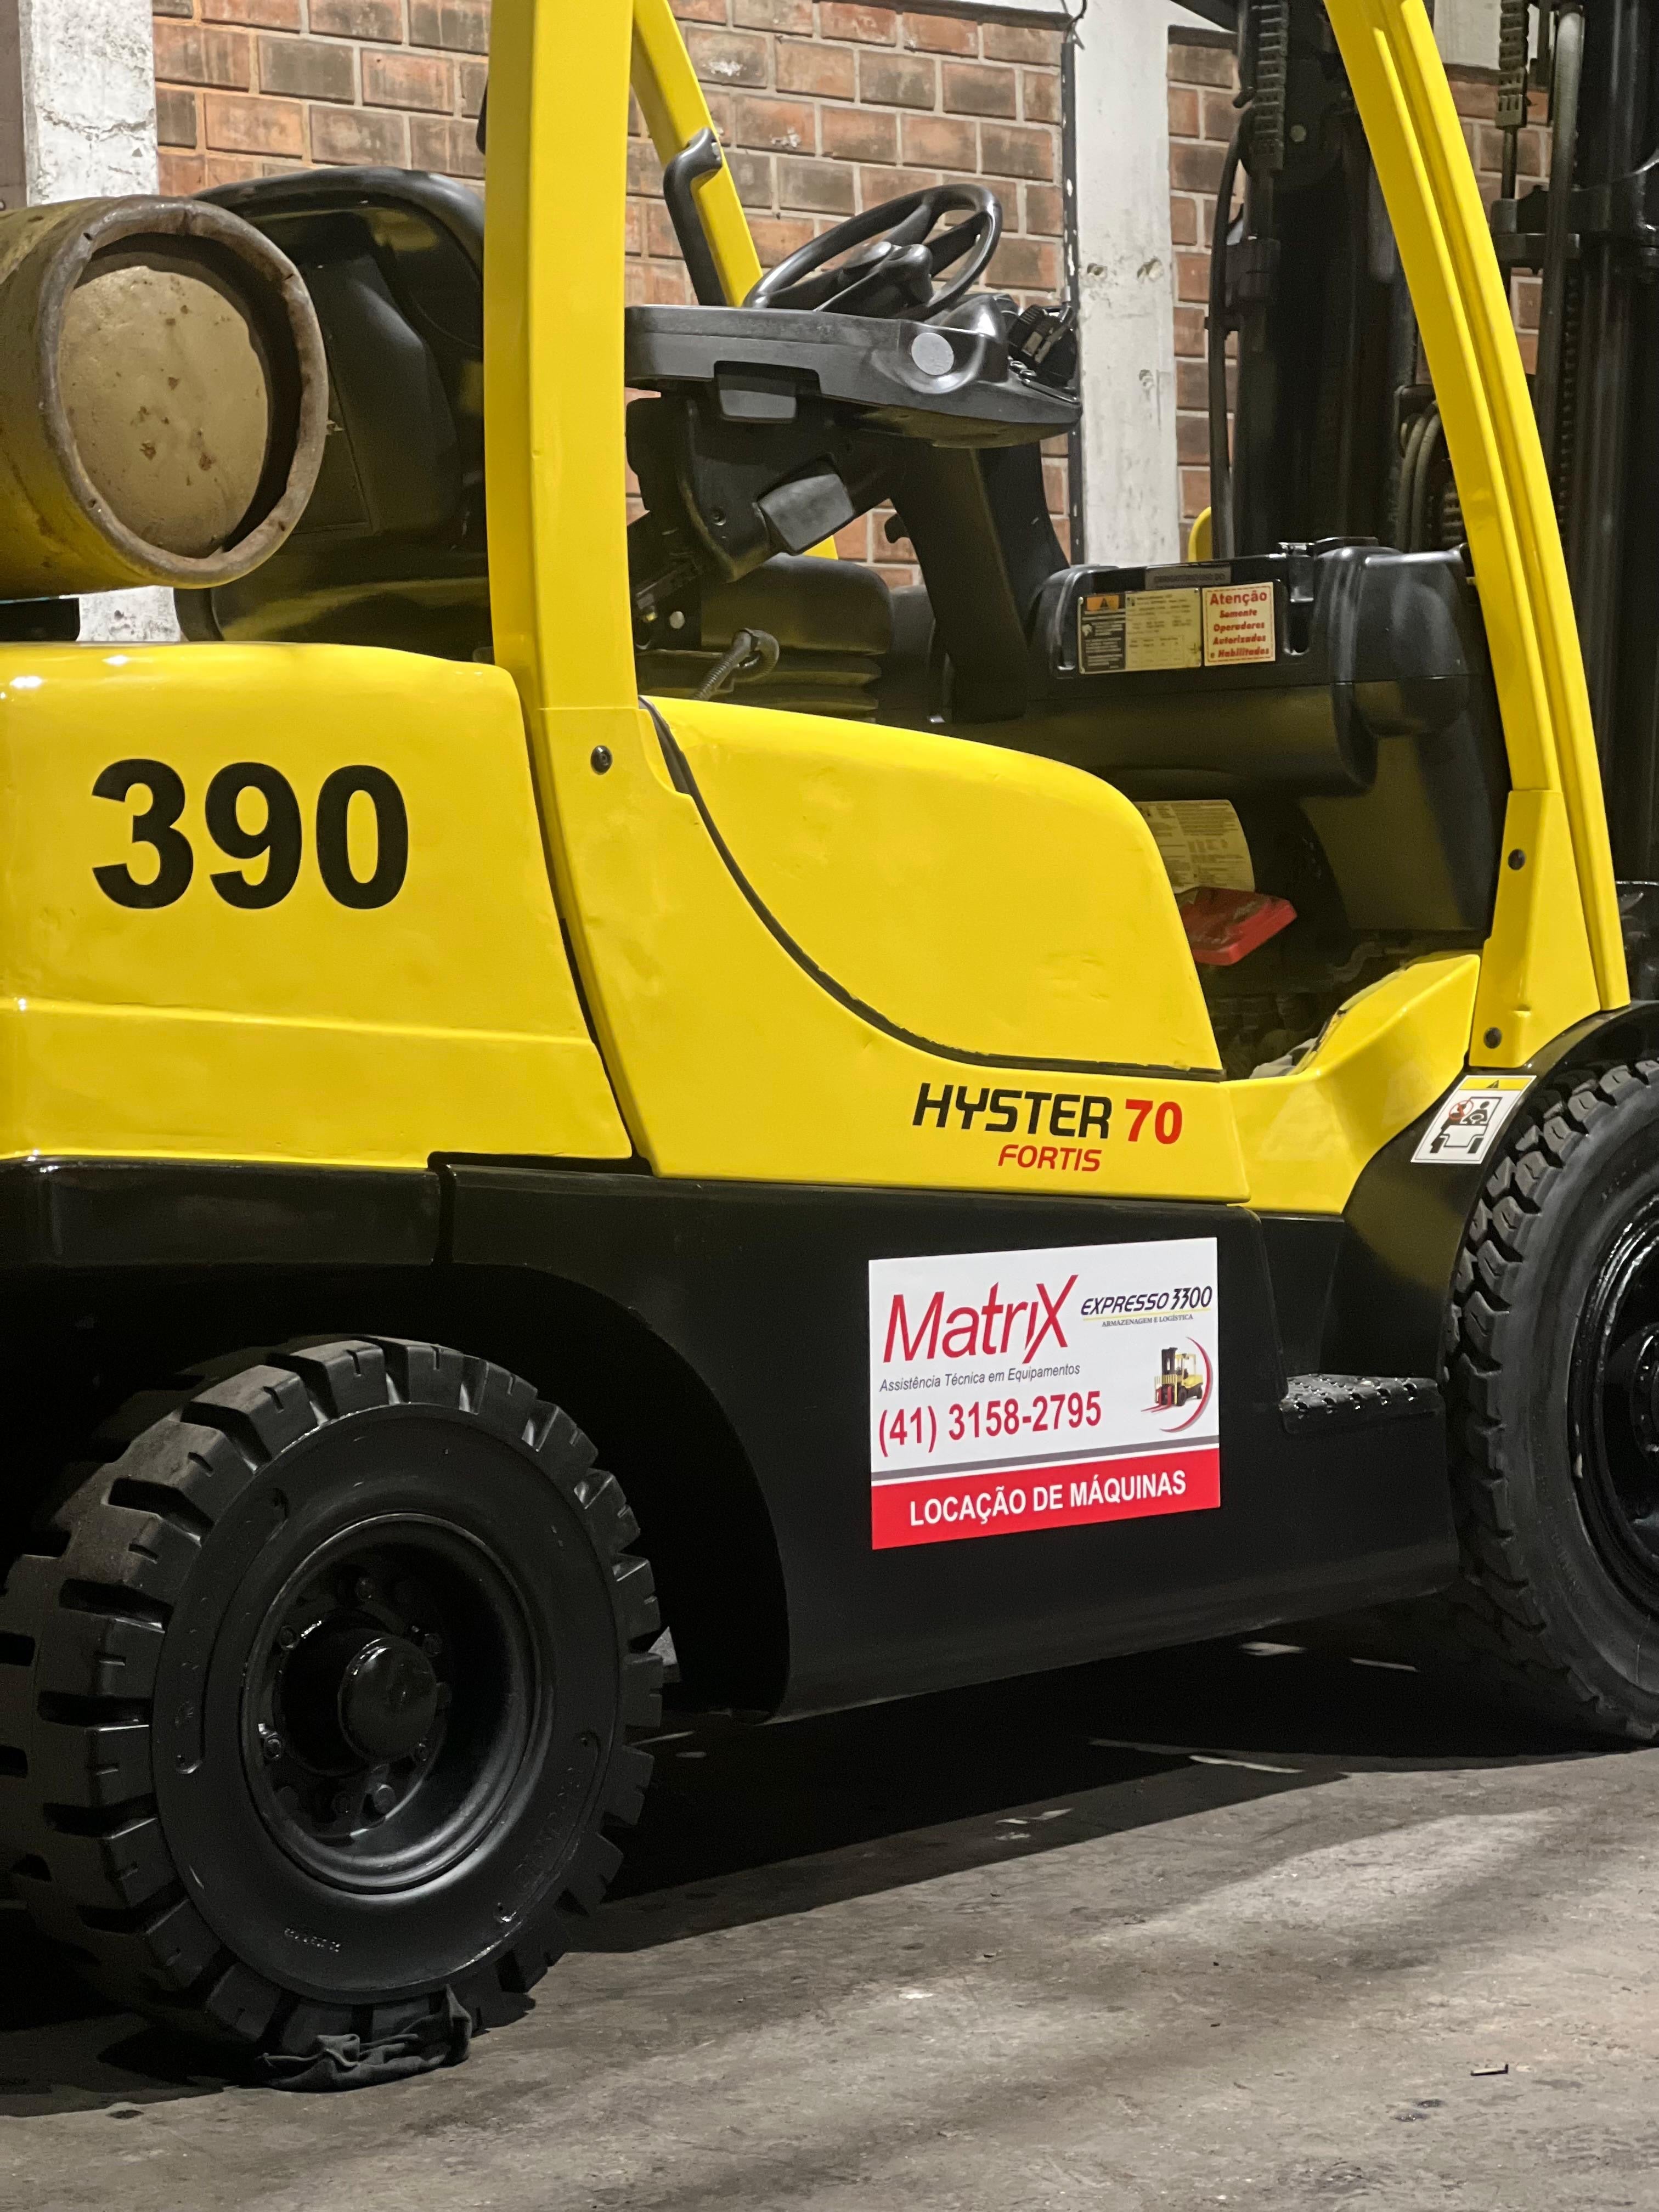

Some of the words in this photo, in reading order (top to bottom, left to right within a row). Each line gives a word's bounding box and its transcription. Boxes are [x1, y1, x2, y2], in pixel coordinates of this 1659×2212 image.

[1210, 590, 1267, 606] Atenção
[1220, 609, 1257, 618] Somente
[1213, 633, 1266, 645] Autorizados
[1214, 622, 1265, 634] Operadores
[1218, 646, 1269, 658] Habilitados
[92, 759, 408, 909] 390
[912, 1082, 1112, 1139] HYSTER
[1125, 1099, 1182, 1144] 70
[998, 1144, 1102, 1172] FORTIS
[1081, 1293, 1170, 1315] EXPRESSO
[1170, 1285, 1212, 1310] 3300
[1102, 1317, 1153, 1327] ARMAZENAGEM
[1159, 1313, 1193, 1323] LOGÍSTICA
[879, 1375, 940, 1392] Assistência
[945, 1372, 985, 1386] Técnica
[989, 1373, 1005, 1381] em
[1008, 1364, 1080, 1382] Equipamentos
[879, 1406, 936, 1457] (41)
[949, 1391, 1101, 1441] 3158-2795
[910, 1485, 1026, 1526] LOCAÇÃO
[1033, 1484, 1063, 1511] DE
[1070, 1470, 1186, 1507] MÁQUINAS
